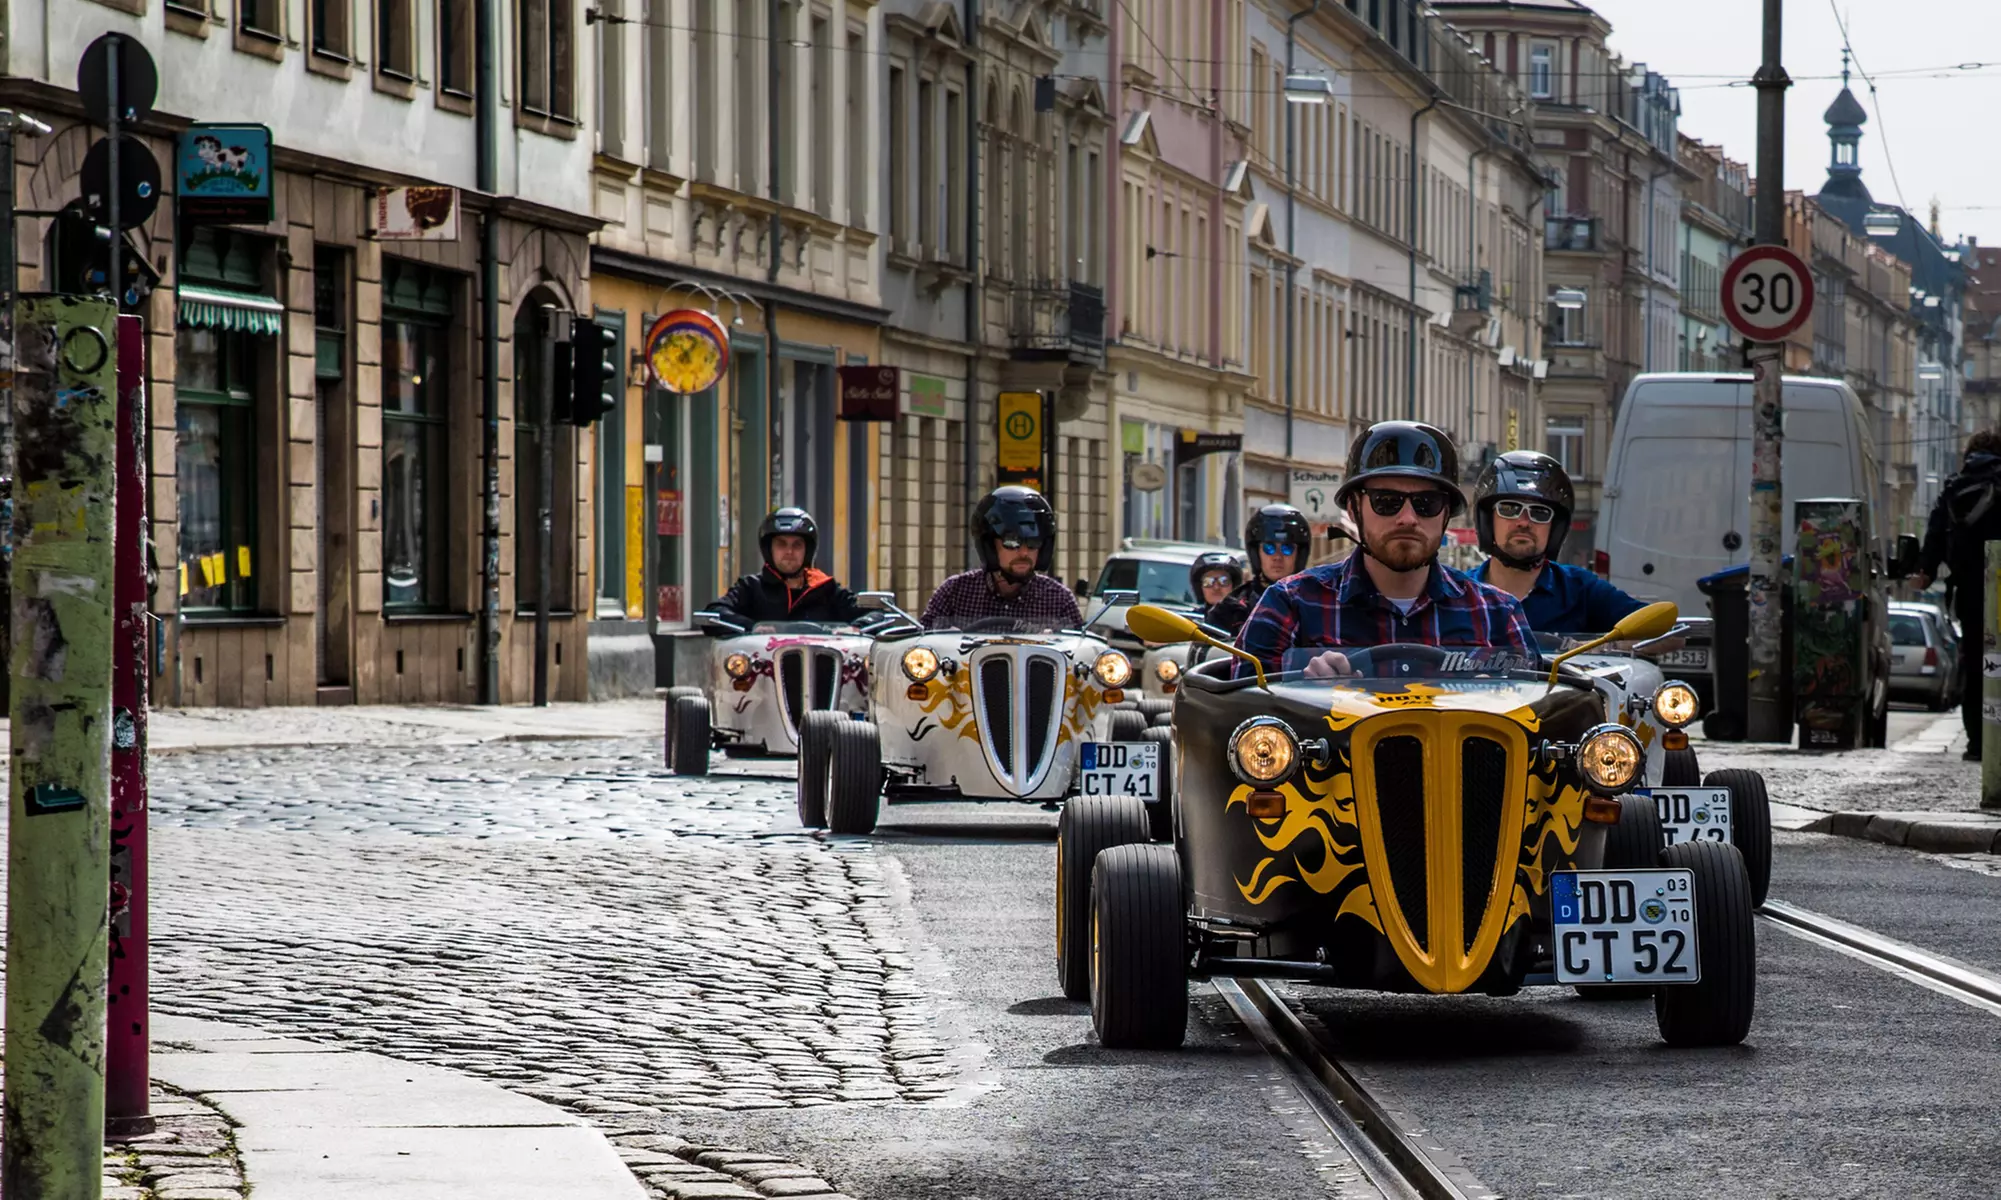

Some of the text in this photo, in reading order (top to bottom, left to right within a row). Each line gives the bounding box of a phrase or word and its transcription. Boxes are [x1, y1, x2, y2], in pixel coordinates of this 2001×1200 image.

[1741, 272, 1794, 315] 30
[1014, 415, 1027, 434] H
[1293, 472, 1339, 482] Schuhe
[1681, 650, 1706, 664] 513
[1144, 745, 1157, 753] 03
[1085, 759, 1092, 767] D
[1096, 745, 1127, 768] DD
[1145, 761, 1157, 769] 10
[1085, 773, 1153, 797] CT 41
[1712, 793, 1727, 803] 03
[1653, 794, 1691, 824] DD
[1714, 814, 1728, 824] 10
[1667, 878, 1688, 892] 03
[1580, 879, 1637, 925] DD
[1561, 904, 1572, 918] D
[1671, 908, 1690, 923] 10
[1562, 929, 1688, 975] CT 52
